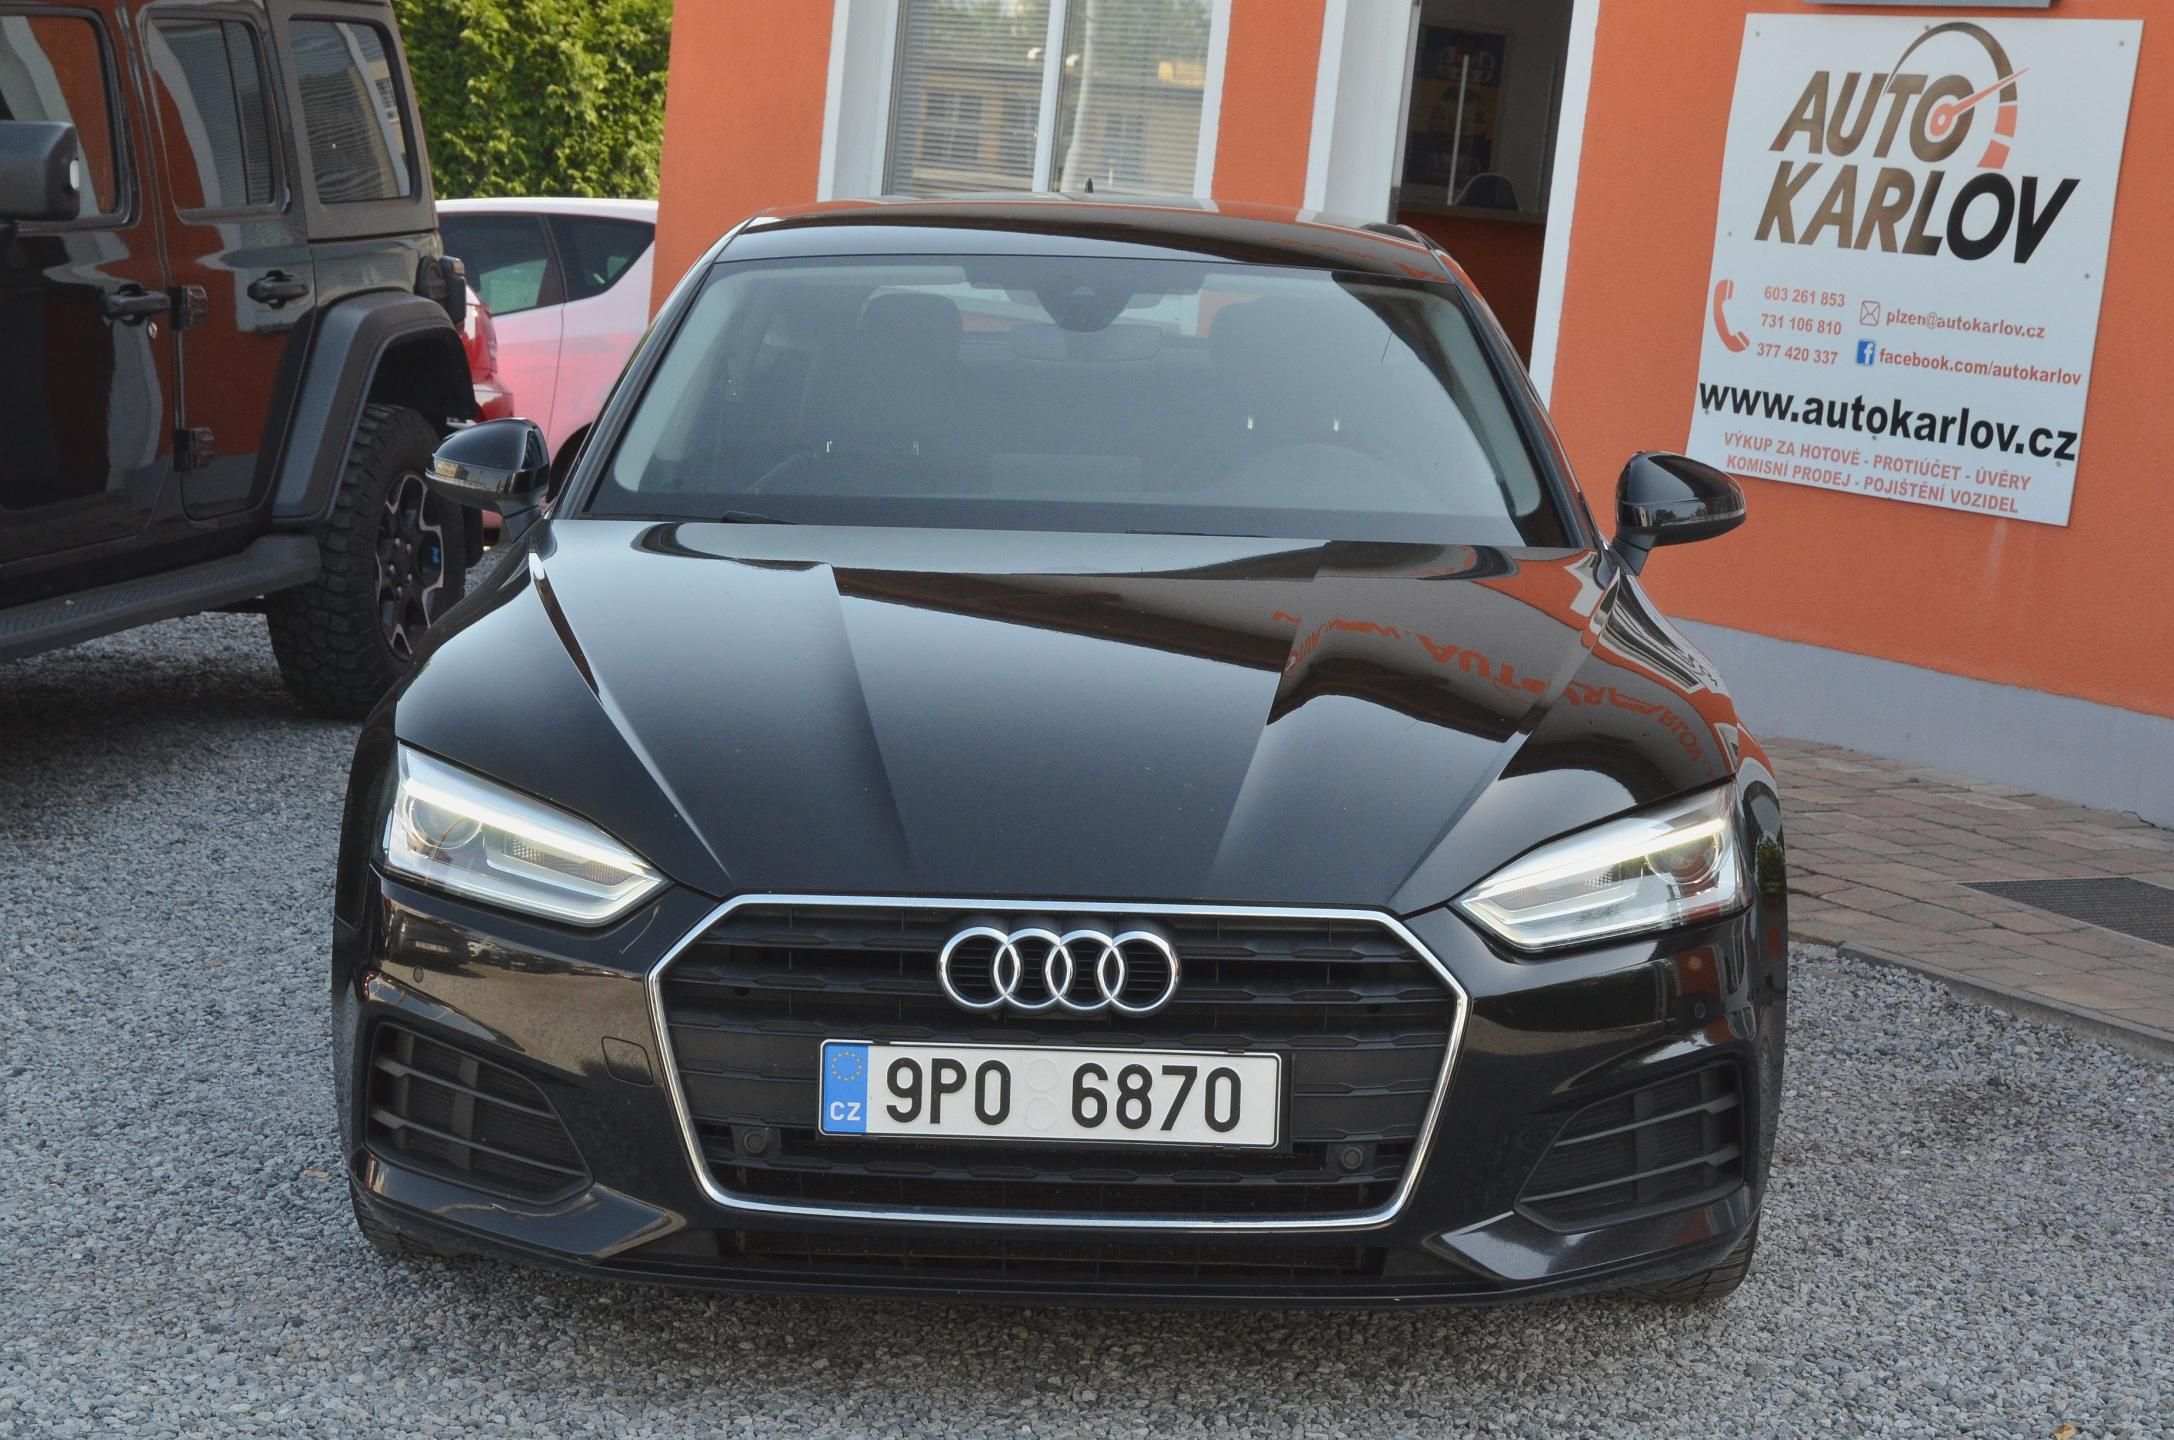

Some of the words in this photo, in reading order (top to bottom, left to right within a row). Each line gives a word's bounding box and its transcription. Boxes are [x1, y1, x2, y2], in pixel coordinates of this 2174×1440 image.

[1769, 70, 1976, 163] AUTO
[1754, 160, 2081, 264] KARLOV
[1764, 286, 1788, 301] 603
[1792, 288, 1816, 304] 261
[1820, 291, 1845, 307] 853
[1761, 313, 1784, 329] 731
[1790, 316, 1813, 332] 106
[1817, 320, 1842, 335] 810
[1886, 308, 2045, 339] plzen@autokarlov.cz
[1757, 342, 1781, 358] 377
[1784, 346, 1809, 361] 420
[1813, 349, 1838, 365] 337
[1879, 347, 2082, 385] facebook.com/autokarlov
[1699, 383, 2078, 461] www.autokarlov.cz
[1724, 430, 1773, 452] VÝKUP
[1776, 440, 1795, 456] ZA
[1800, 443, 1861, 466] HOTOVÉ
[1873, 454, 1962, 480] PROTIÚČET
[1975, 466, 2032, 491] ÚVĚRY
[1726, 454, 1789, 477] KOMISNÍ
[1792, 464, 1852, 487] PRODEJ
[1864, 475, 1947, 502] POJIŠTĚNÍ
[1951, 488, 2018, 513] VOZIDEL
[830, 1101, 861, 1121] CZ
[886, 1057, 1011, 1125] 9P0
[1071, 1062, 1242, 1133] 6870
